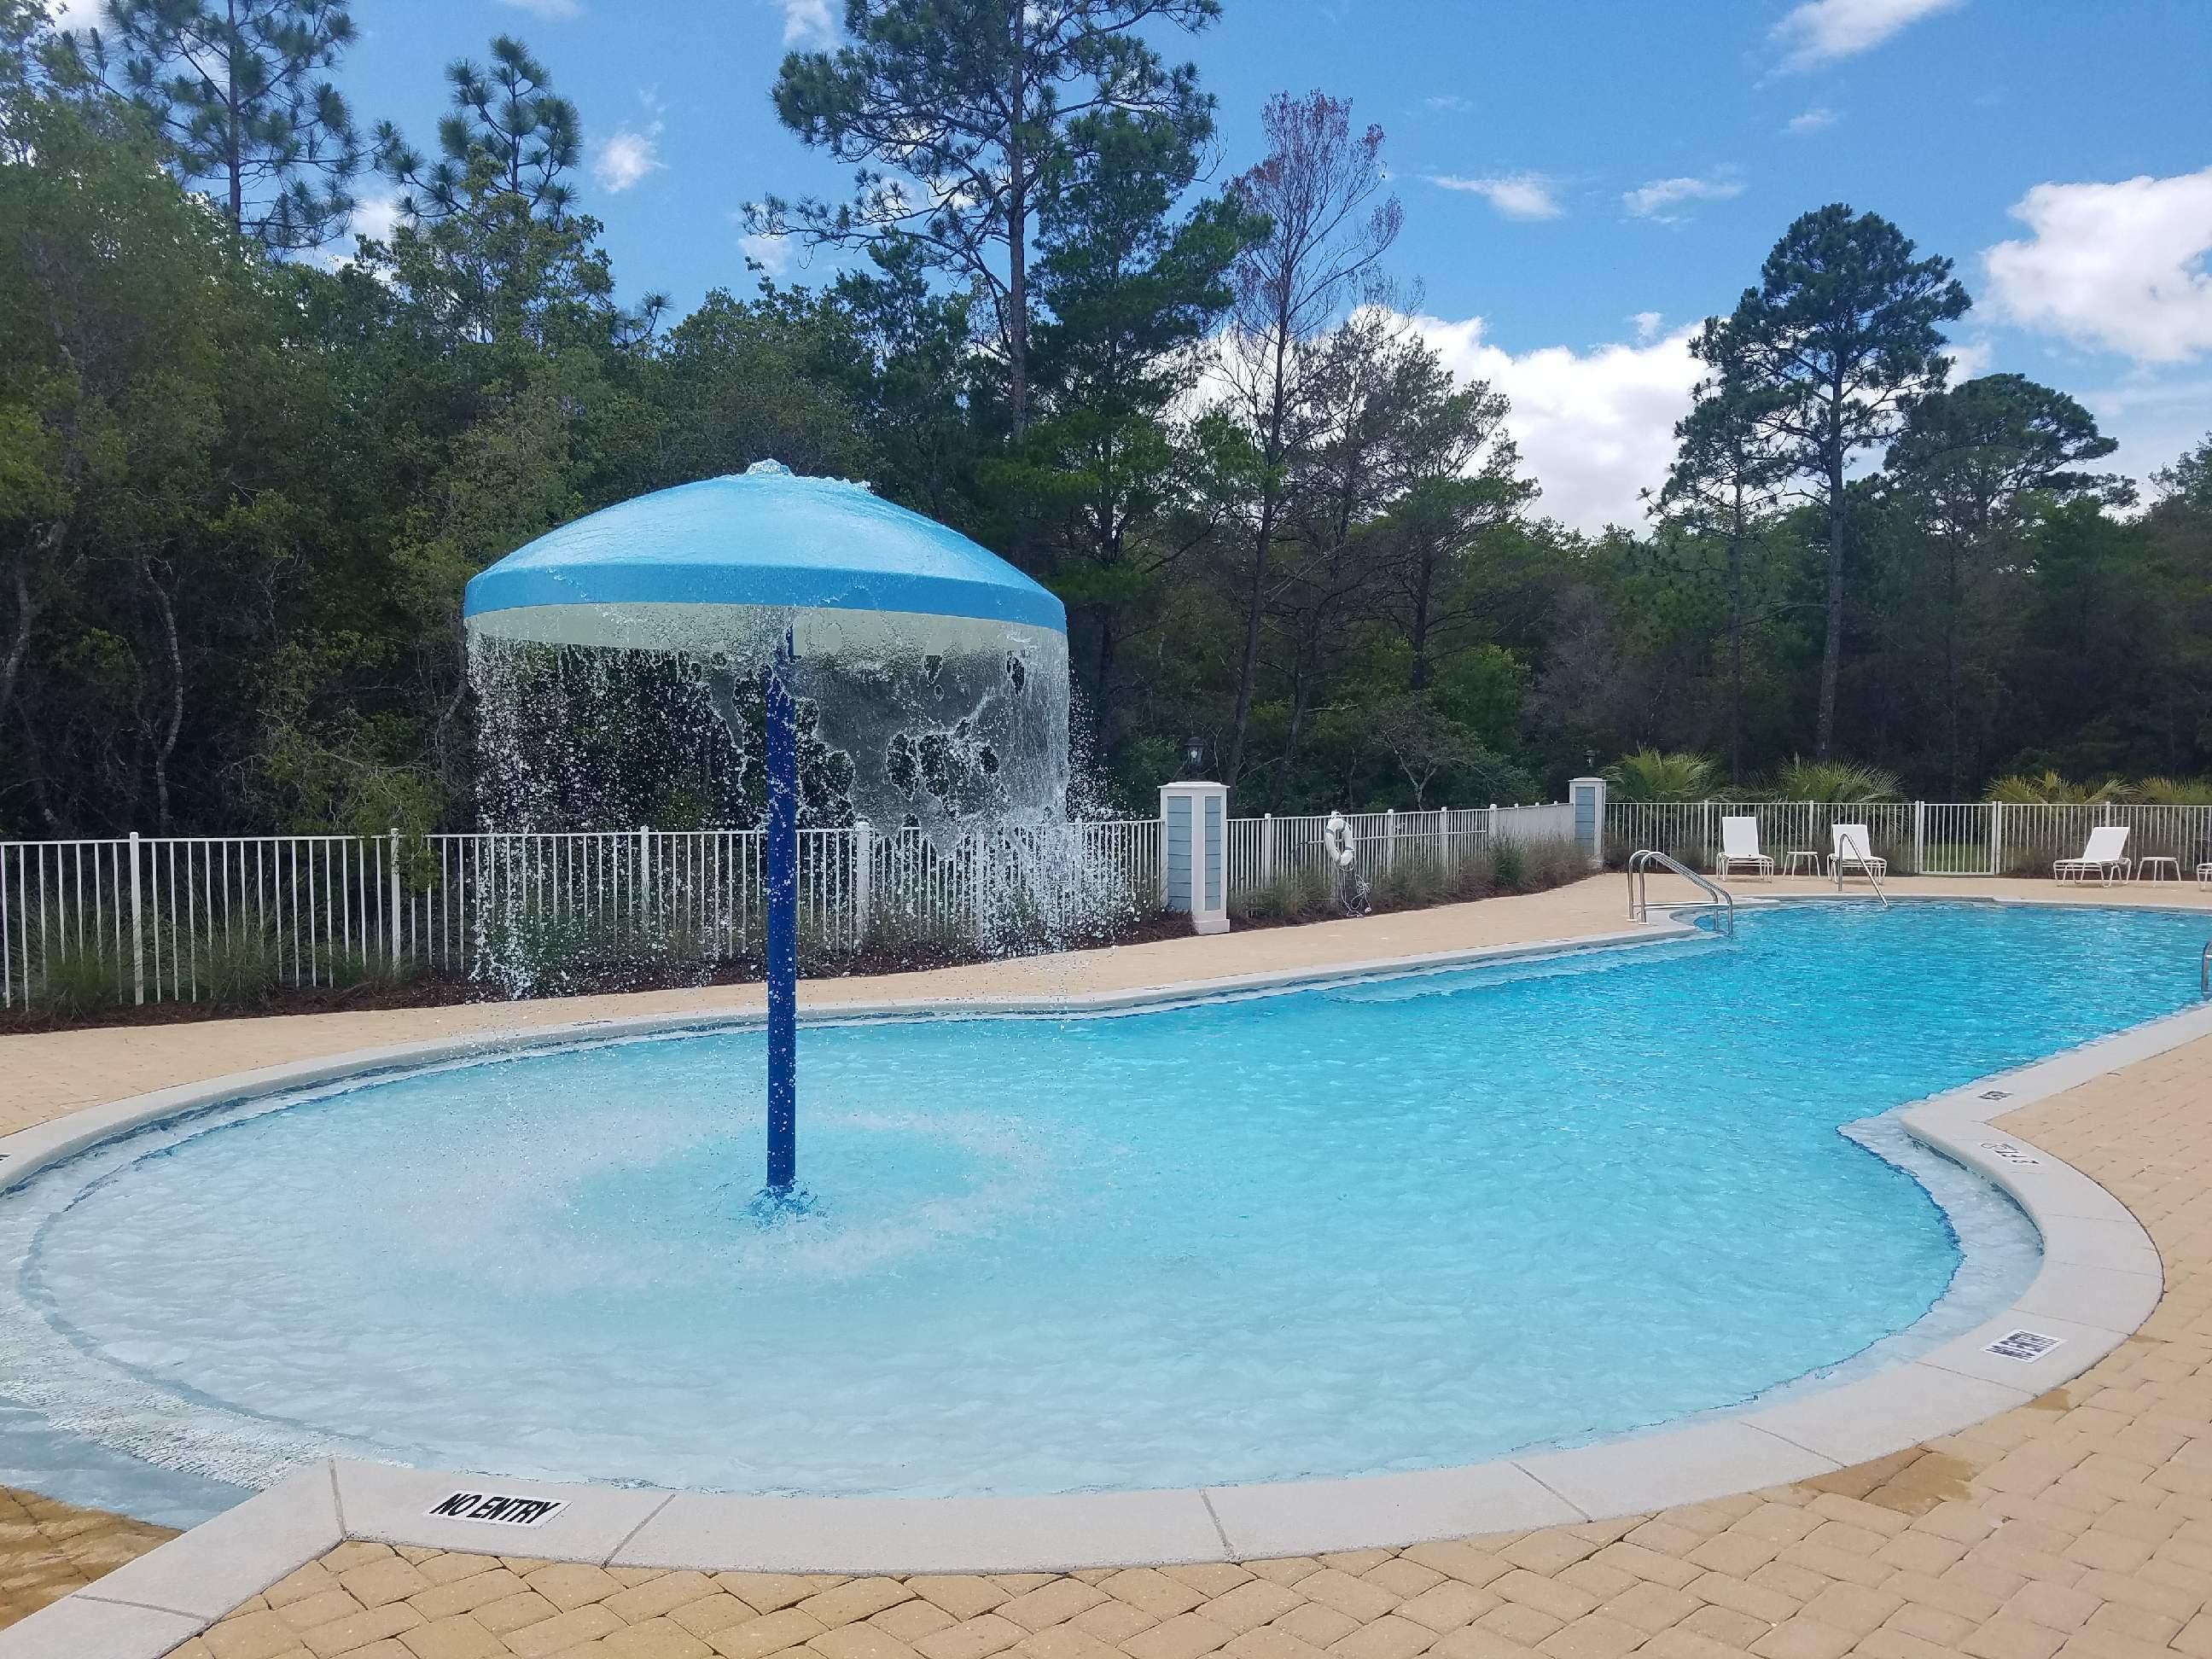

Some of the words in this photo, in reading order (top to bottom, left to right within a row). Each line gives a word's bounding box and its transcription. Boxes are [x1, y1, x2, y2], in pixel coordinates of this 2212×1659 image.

[1985, 1344, 2035, 1360] NO
[1998, 1330, 2059, 1353] ENTRY
[429, 1493, 482, 1516] NO
[466, 1496, 561, 1523] ENTRY
